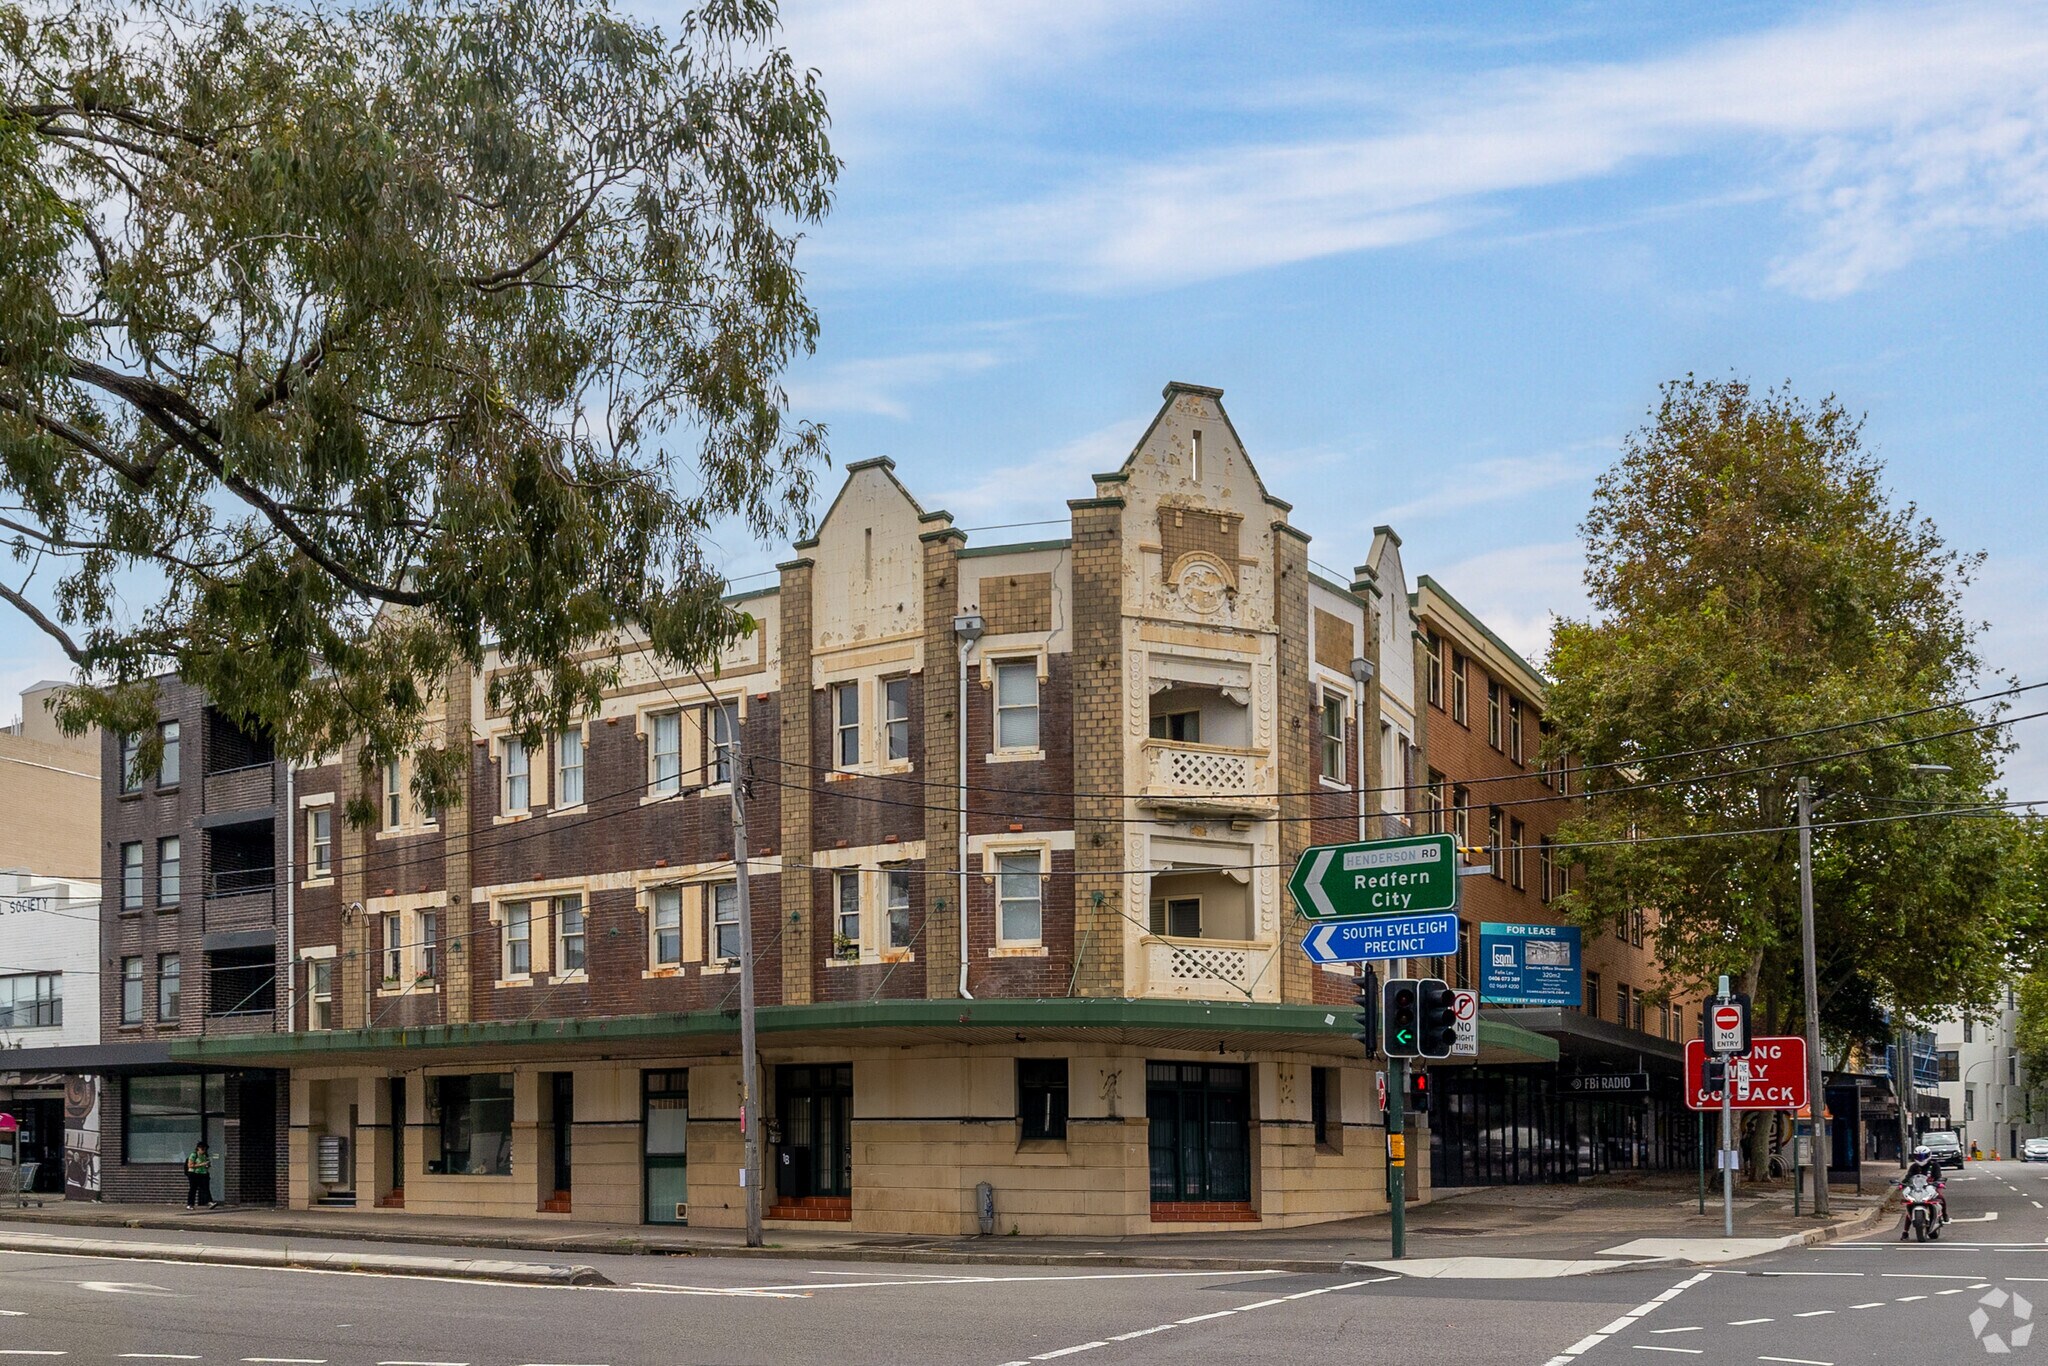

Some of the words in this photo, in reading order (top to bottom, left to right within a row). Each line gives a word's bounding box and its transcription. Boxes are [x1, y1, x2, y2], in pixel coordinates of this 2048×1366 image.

[1346, 849, 1416, 867] HENDERSON
[1421, 848, 1437, 859] RD
[1354, 871, 1430, 890] Redfern
[10, 897, 48, 914] SOCIETY
[1371, 892, 1412, 909] City
[1342, 926, 1383, 940] SOUTH
[1387, 920, 1447, 936] EVELEIGH
[1506, 925, 1525, 934] FOR
[1528, 927, 1557, 936] LEASE
[1364, 938, 1426, 953] PRECINCT
[1457, 1022, 1471, 1032] NO
[1455, 1043, 1474, 1051] TURN
[1584, 1076, 1600, 1090] FBi
[1601, 1076, 1631, 1089] RADIO
[1737, 1086, 1794, 1101] ACK
